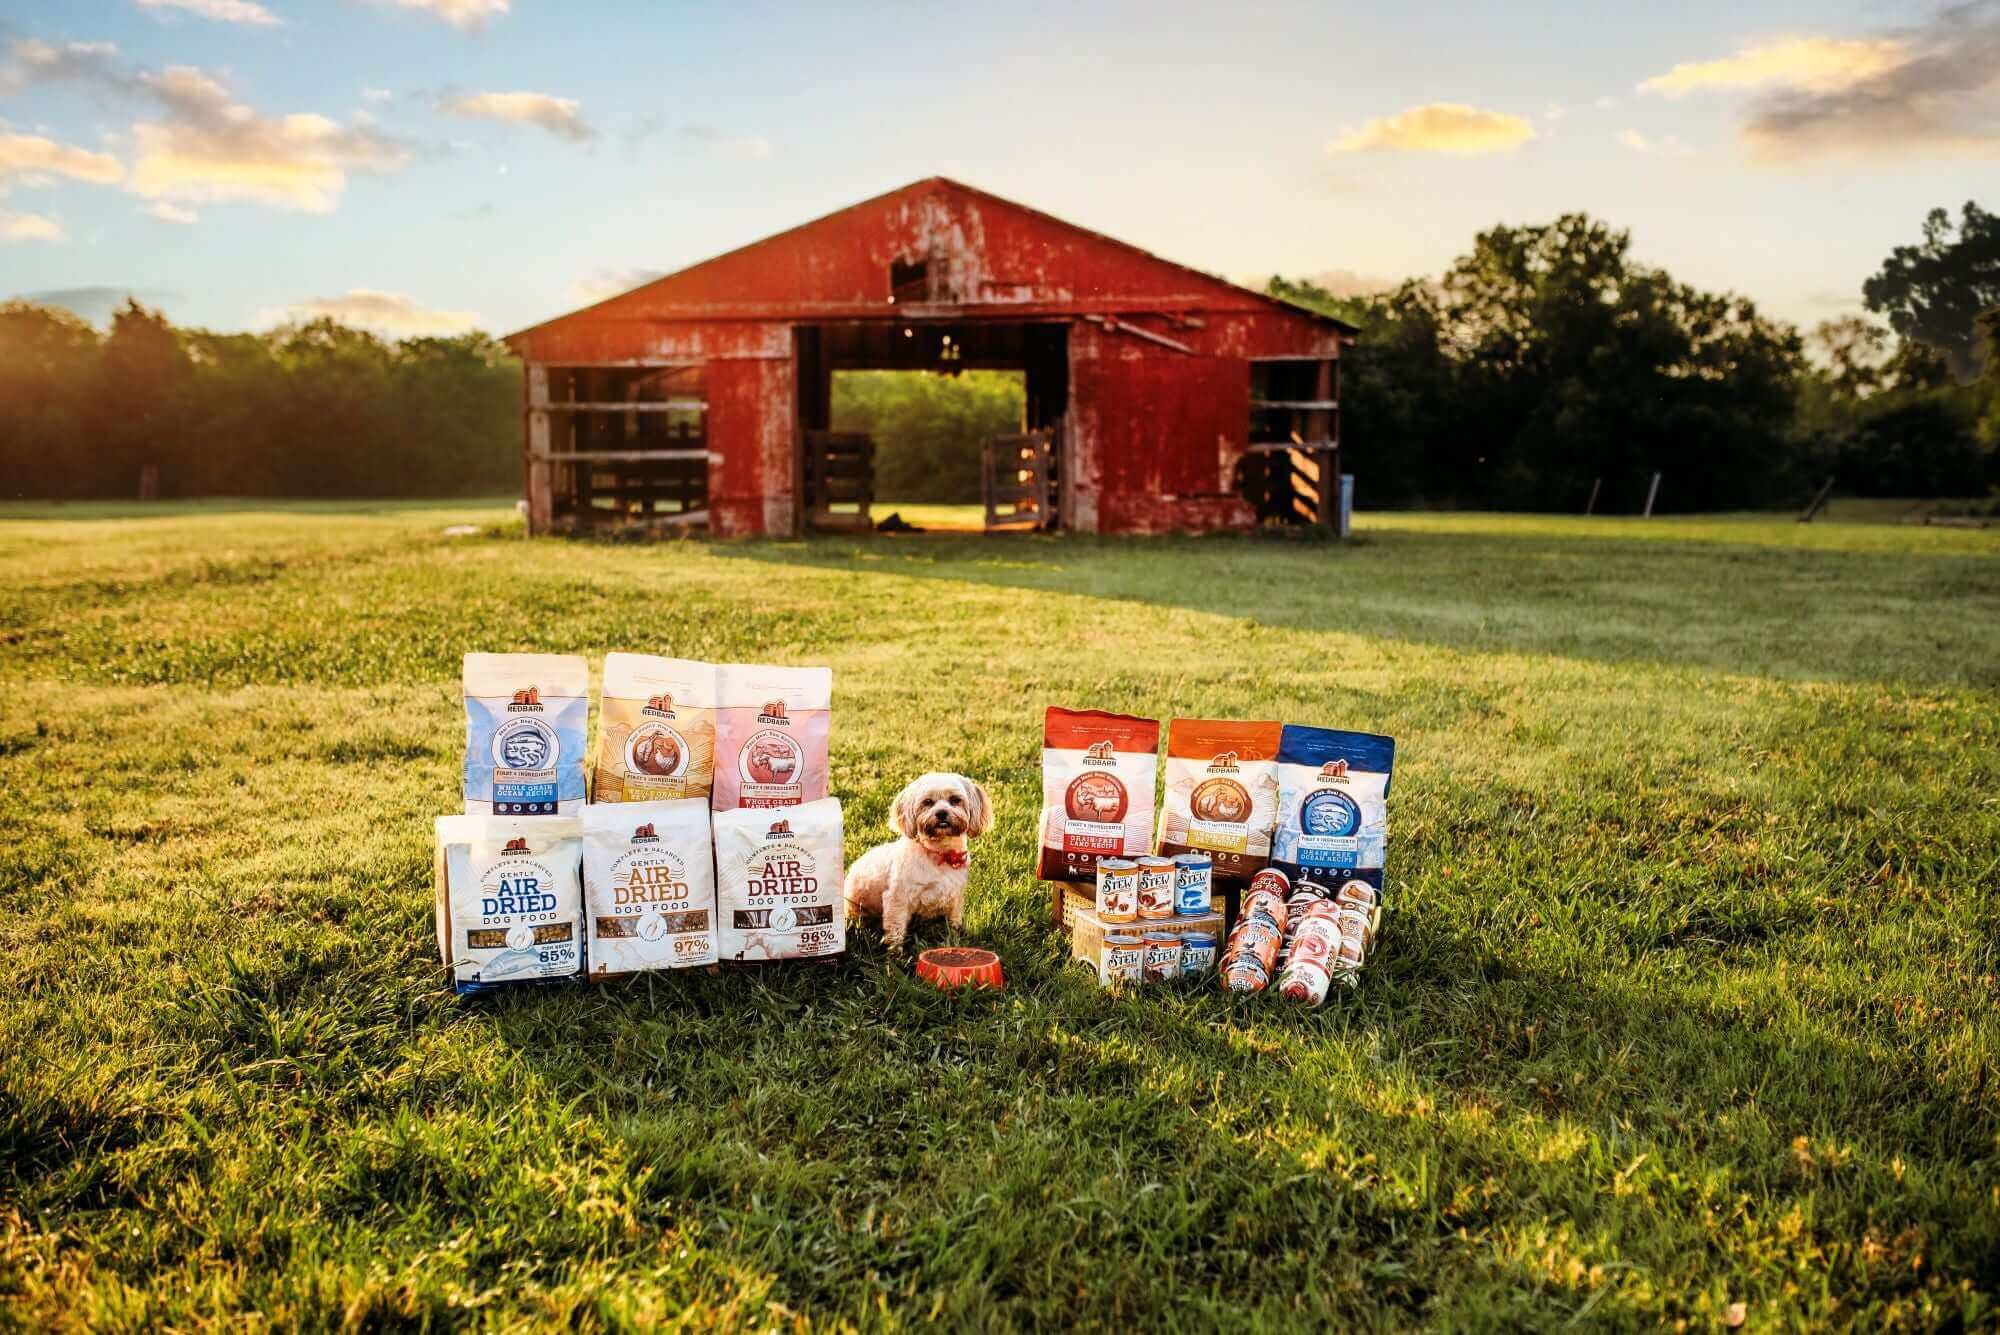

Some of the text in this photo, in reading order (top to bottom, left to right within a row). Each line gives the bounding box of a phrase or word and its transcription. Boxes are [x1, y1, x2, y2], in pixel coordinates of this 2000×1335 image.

[642, 709, 676, 720] REDBARN
[757, 717, 790, 726] REDBARN
[1083, 759, 1117, 767] REDBARN
[1316, 776, 1350, 785] REDBARN
[1303, 849, 1329, 857] GRAIN
[631, 859, 665, 867] GENTLY
[761, 861, 803, 879] AIR
[500, 871, 535, 879] GENTLY
[628, 866, 673, 885] AIR
[1140, 873, 1170, 889] STEW
[1177, 871, 1207, 888] STEW
[497, 878, 541, 897] AIR
[747, 877, 818, 897] DRIED
[1102, 878, 1133, 893] STEW
[613, 882, 689, 905] DRIED
[748, 895, 818, 905] DOG FOOD
[482, 893, 557, 916] DRIED
[615, 902, 689, 914] DOG FOOD
[483, 912, 557, 925] DOG FOOD
[800, 930, 835, 944] 96%
[673, 940, 710, 954] 97%
[539, 949, 576, 963] 85%
[1108, 951, 1138, 967] STEW
[1147, 948, 1177, 964] STEW
[1181, 947, 1211, 963] STEW
